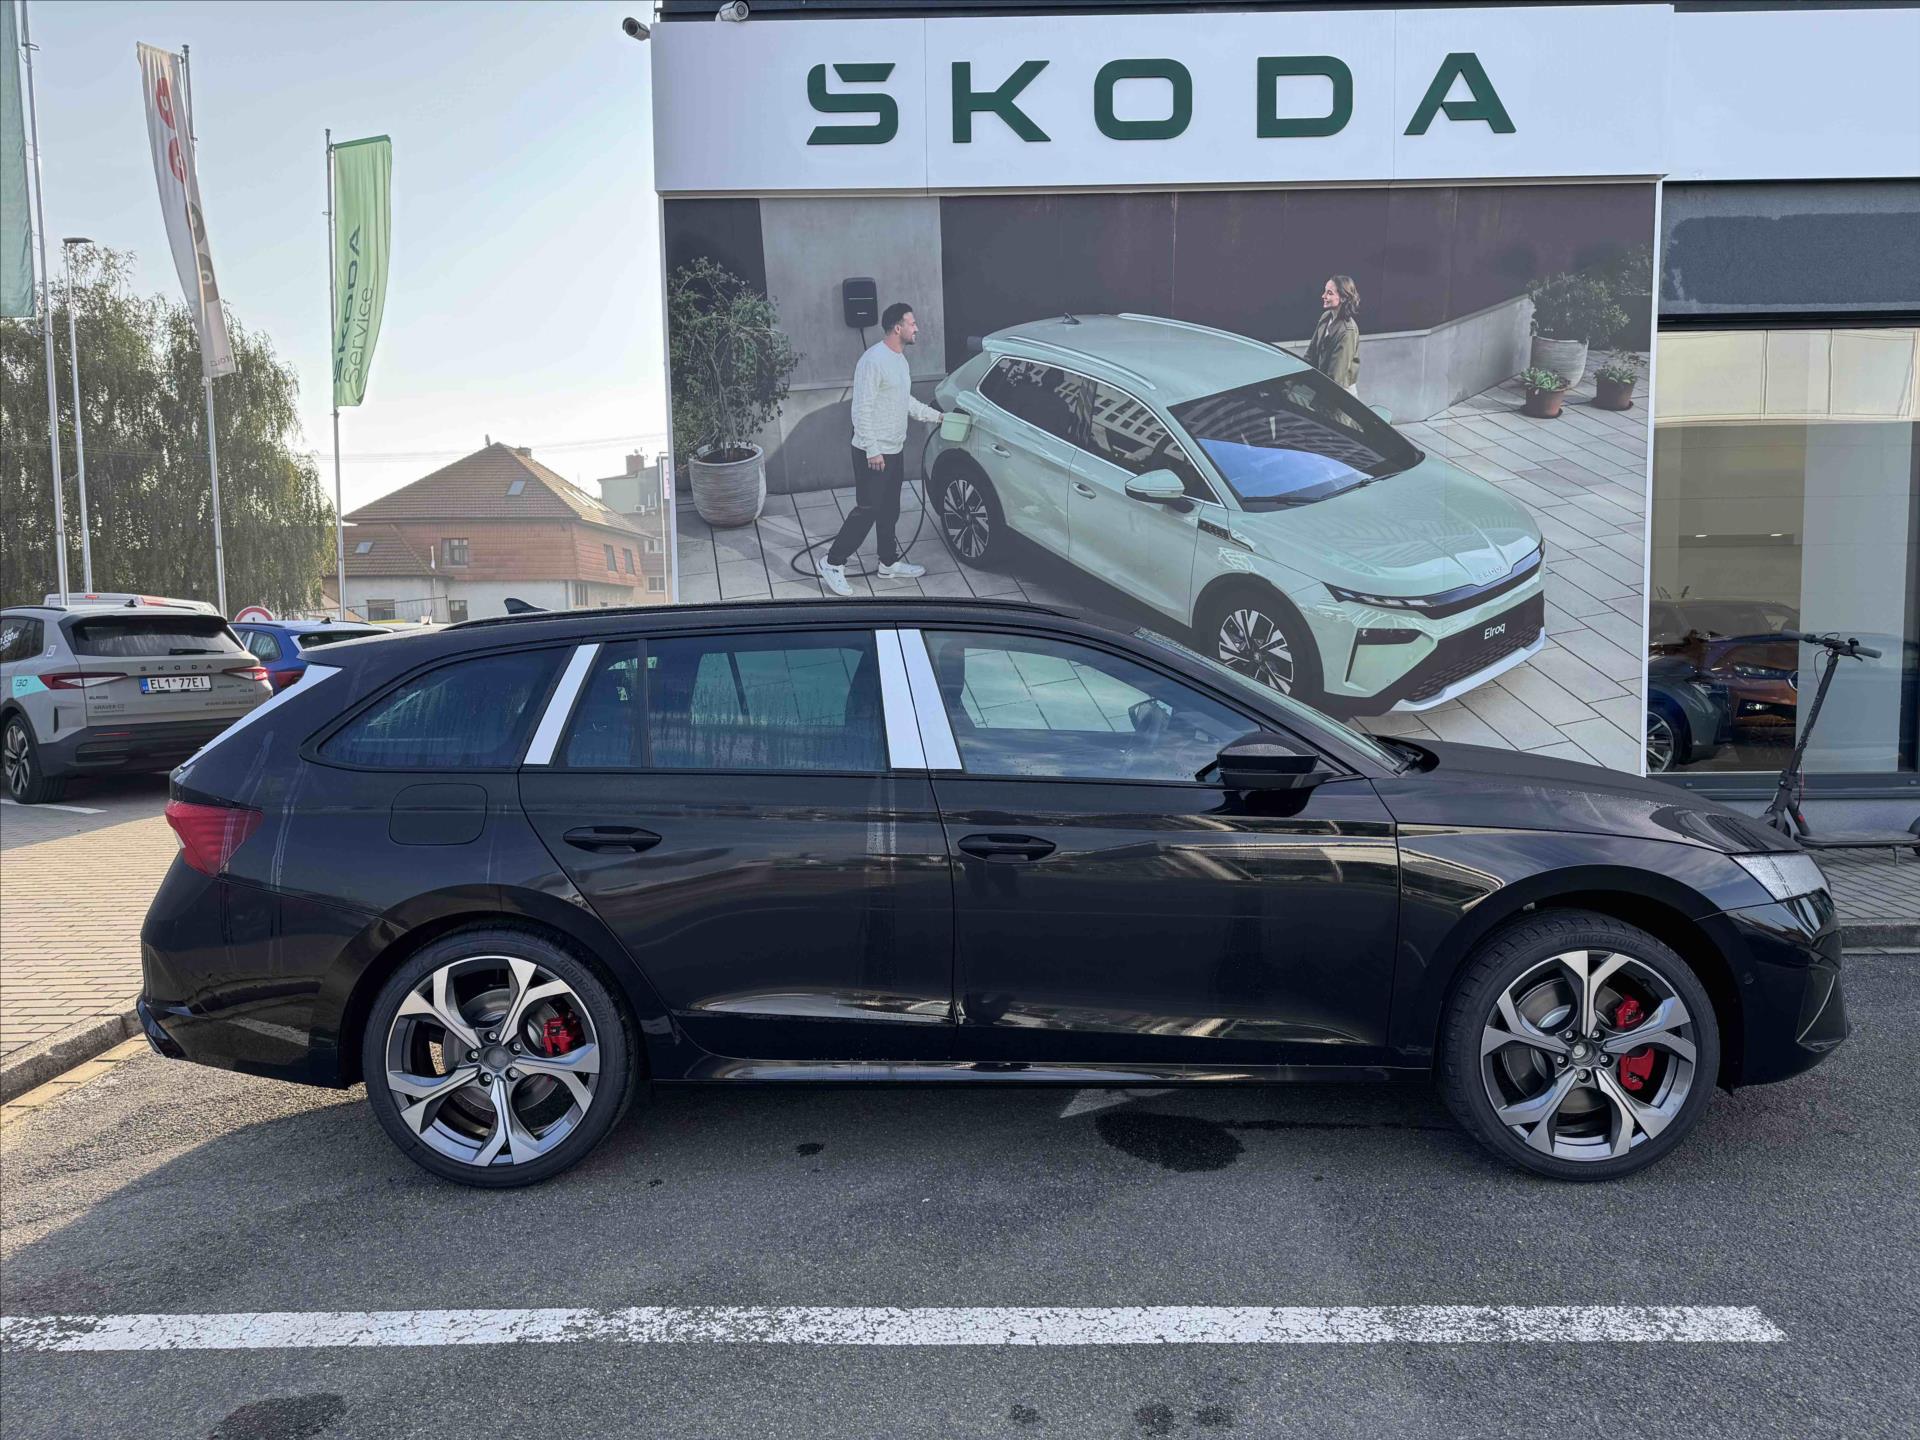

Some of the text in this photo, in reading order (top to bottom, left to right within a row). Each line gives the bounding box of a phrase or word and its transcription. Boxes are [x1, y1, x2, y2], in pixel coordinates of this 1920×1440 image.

[344, 287, 374, 384] Service
[1483, 623, 1506, 640] Elroq
[140, 664, 212, 672] SKODA
